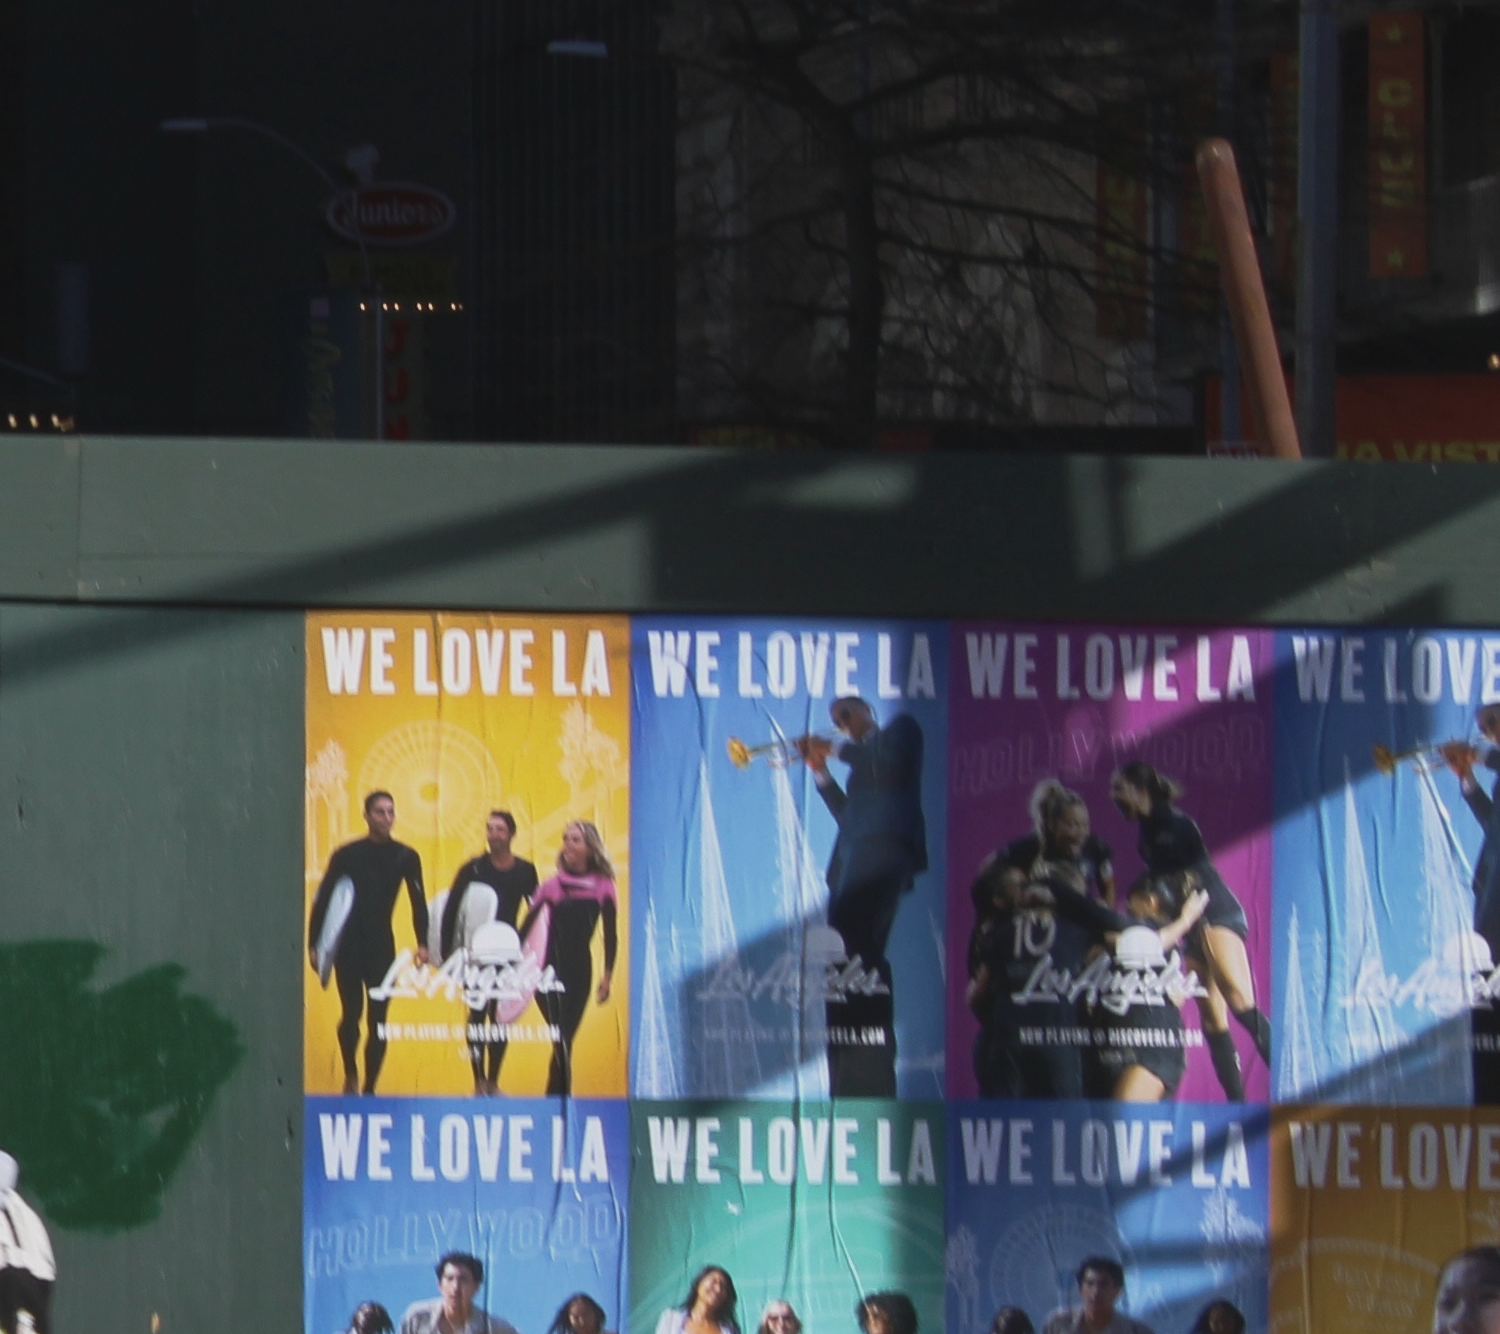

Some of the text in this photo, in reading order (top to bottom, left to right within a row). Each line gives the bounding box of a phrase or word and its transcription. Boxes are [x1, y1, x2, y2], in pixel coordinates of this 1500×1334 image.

[321, 628, 612, 698] WE LOVE LA
[647, 630, 936, 701] WE LOVE LA
[964, 632, 1257, 703] WE LOVE LA
[1292, 636, 1500, 705] WE LOVE
[319, 1113, 610, 1184] WE LOVE LA
[647, 1116, 937, 1187] WE LOVE LA
[960, 1118, 1251, 1189] WE LOVE LA
[1288, 1121, 1500, 1193] WE LOVE
